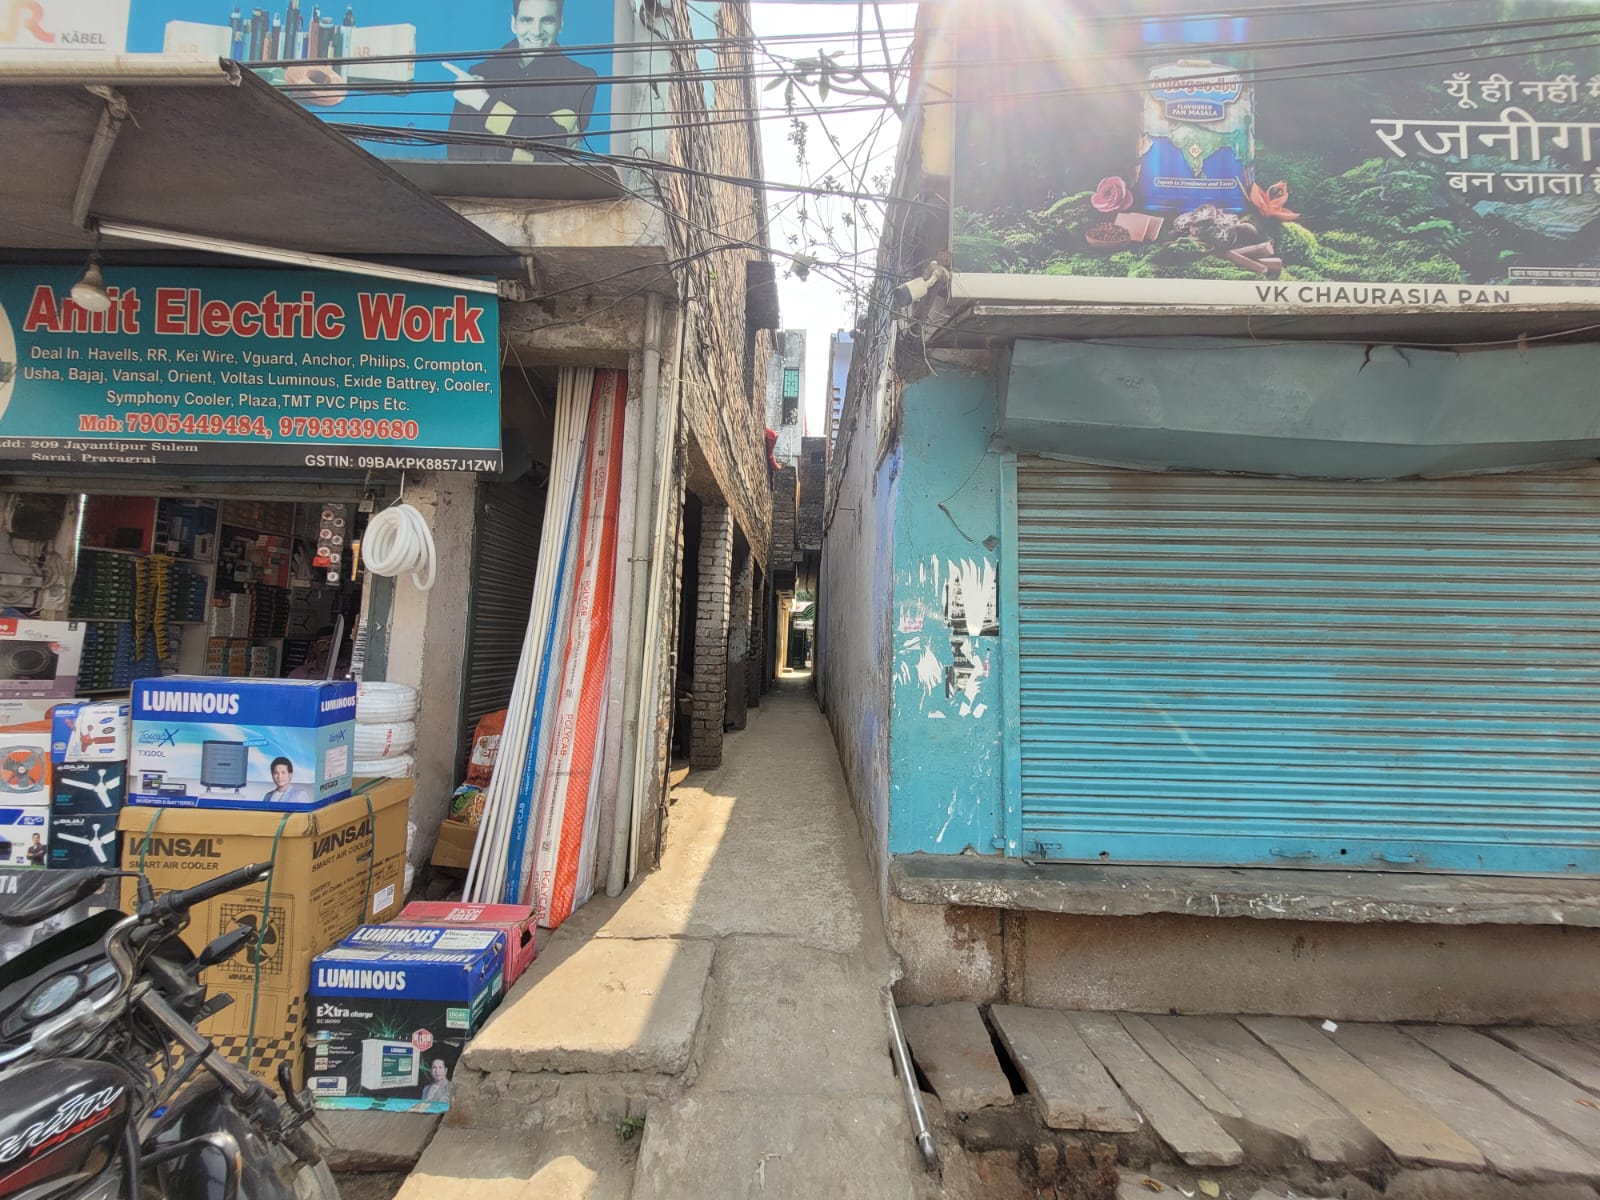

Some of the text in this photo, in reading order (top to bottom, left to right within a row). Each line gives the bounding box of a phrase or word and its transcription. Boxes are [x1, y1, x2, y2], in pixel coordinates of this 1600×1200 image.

[1443, 72, 1478, 109] यूँ
[1478, 73, 1513, 102] ही
[1519, 74, 1578, 103] नहीं
[1445, 172, 1495, 193] बन
[1501, 173, 1584, 195] जाता
[1256, 286, 1510, 305] VK CHAURASIA PAN
[155, 288, 345, 339] Electric
[358, 292, 485, 344] Work
[31, 346, 62, 359] Deal
[88, 347, 143, 362] Havells,
[147, 349, 171, 363] RR,
[176, 350, 198, 362] Kei
[202, 350, 238, 365] Wire,
[243, 351, 298, 367] Vguard,
[302, 353, 355, 368] Anchor,
[359, 354, 409, 371] Philips,
[413, 357, 487, 374] Crompton,
[23, 368, 493, 394] Usha, Bajaj, Vansal, Orient, Voltas Luminous, Exide Battrey, Cooler,
[106, 391, 180, 407] Symphony
[184, 392, 234, 408] Cooler,
[316, 395, 345, 409] PVC
[350, 396, 379, 413] Pips
[384, 397, 410, 411] Etc.
[78, 413, 419, 440] Mob: 7905449484, 9793339680
[31, 440, 59, 450] 209
[64, 440, 147, 452] Jayantipur
[151, 441, 198, 452] Sulem
[305, 455, 354, 468] GSTIN:
[142, 690, 240, 715] LUMINOUS
[320, 696, 356, 713] LUMINOUS
[560, 713, 574, 756] POLYCAB
[129, 838, 221, 858] VANSAL
[312, 819, 372, 860] VANSAL
[129, 860, 219, 870] SMART AIR COOLER
[312, 856, 335, 872] SMART
[336, 850, 347, 860] AIR
[352, 928, 440, 943] LUMINOUS
[318, 968, 406, 991] LUMINOUS
